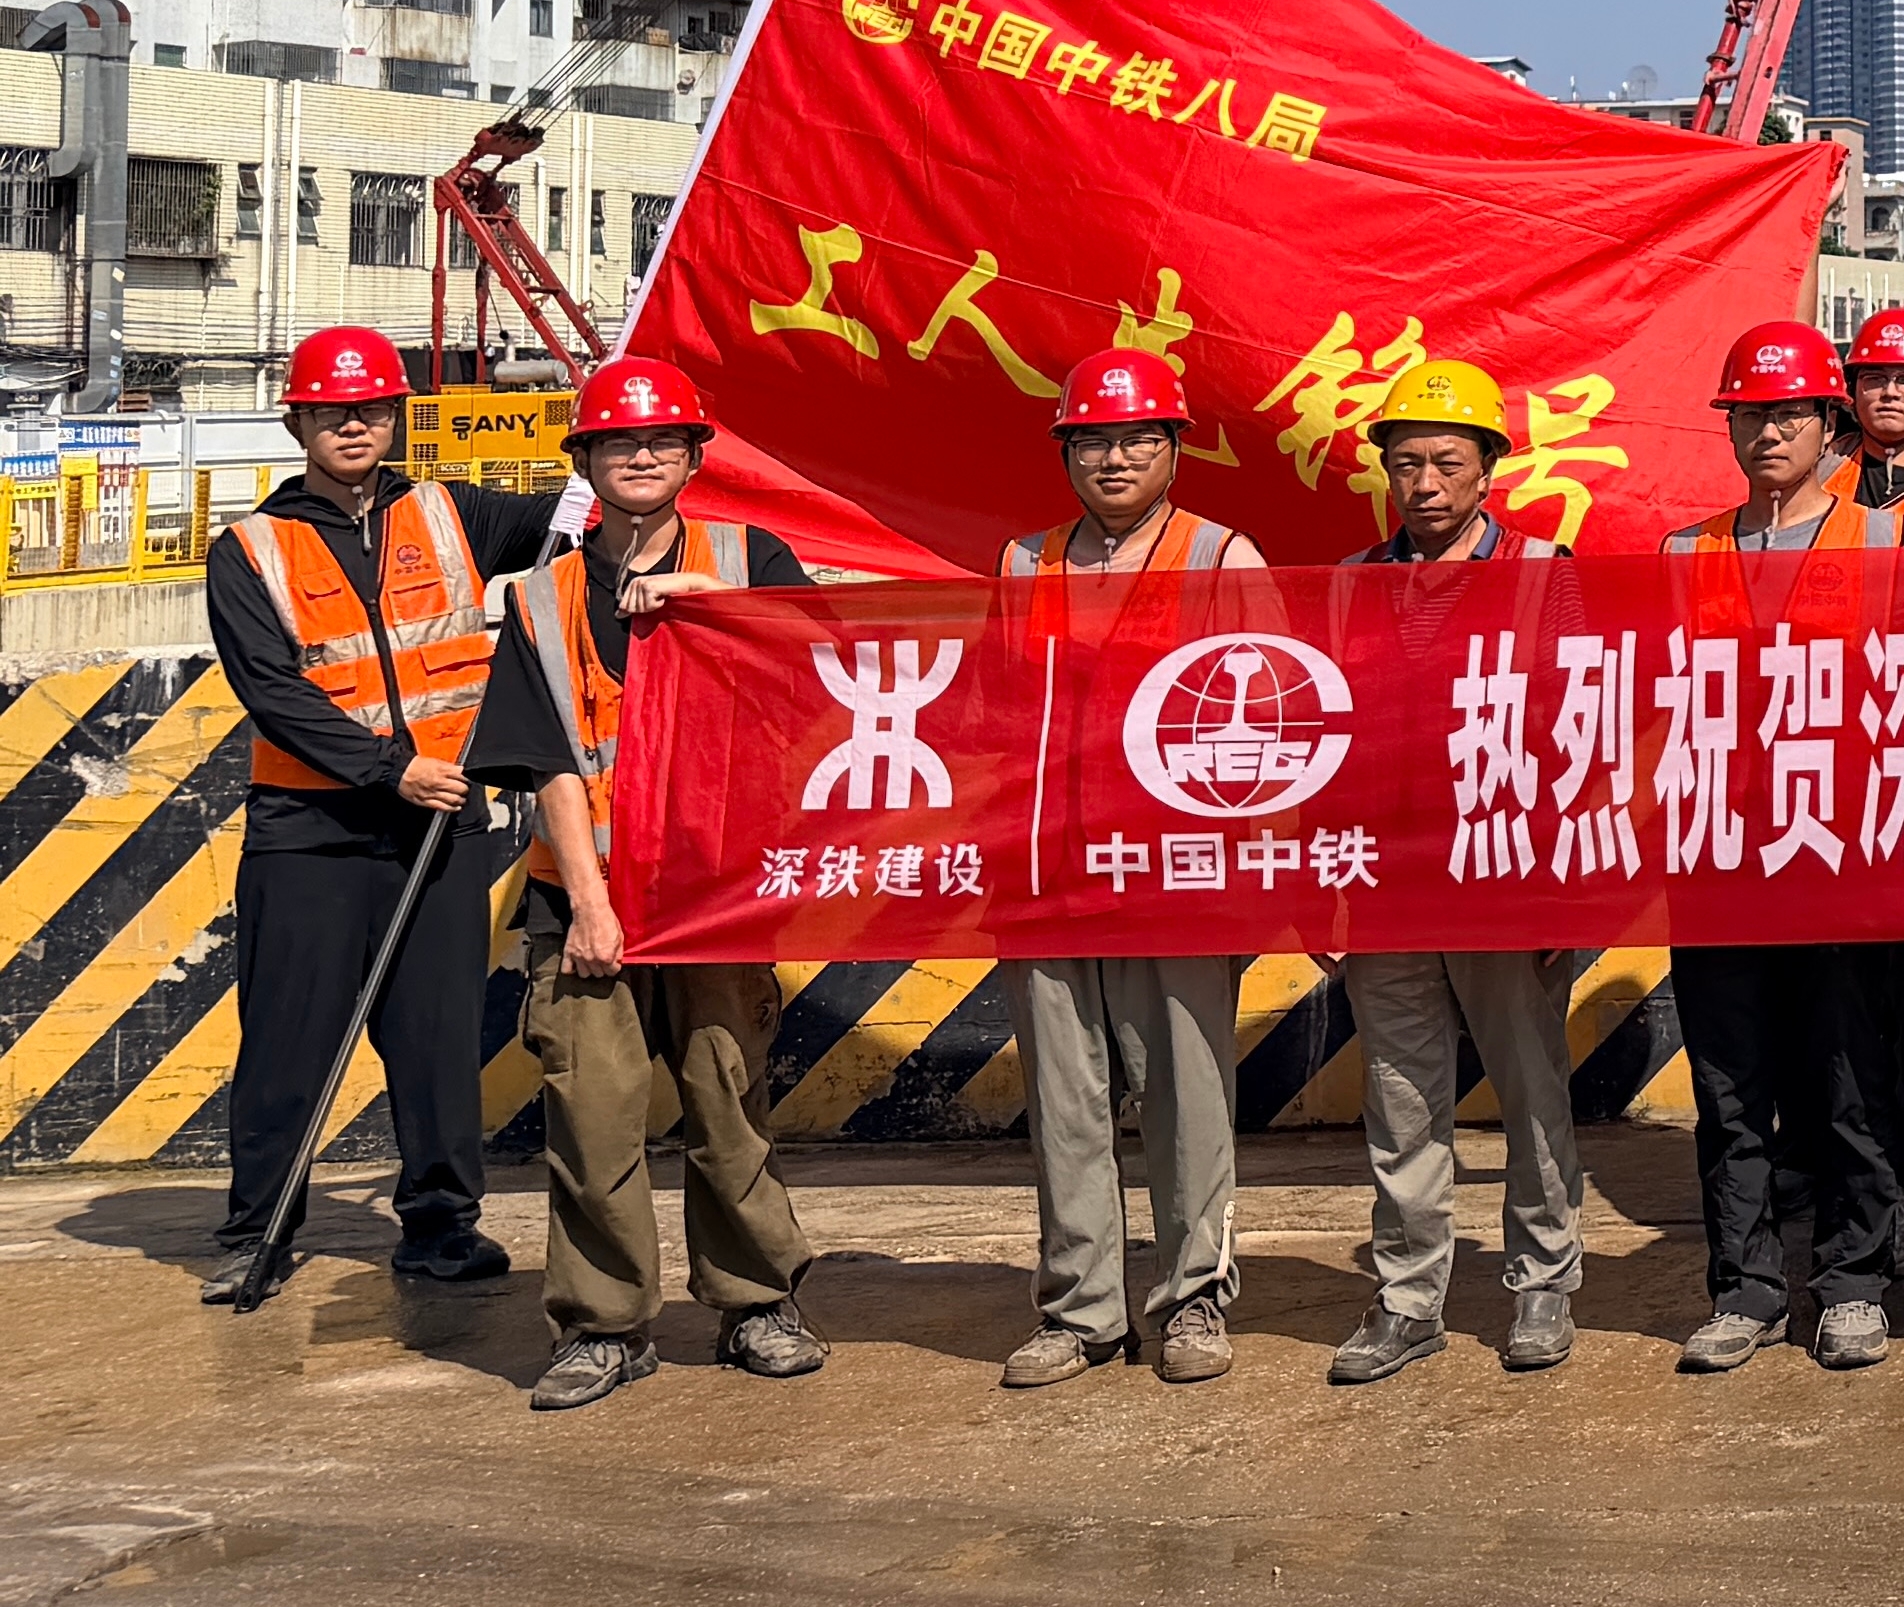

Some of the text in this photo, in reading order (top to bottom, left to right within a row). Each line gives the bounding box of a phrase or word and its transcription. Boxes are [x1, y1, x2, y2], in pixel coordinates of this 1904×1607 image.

[451, 412, 539, 437] SANY
[756, 843, 984, 899] 深铁建设
[1086, 826, 1379, 893] 中国中铁
